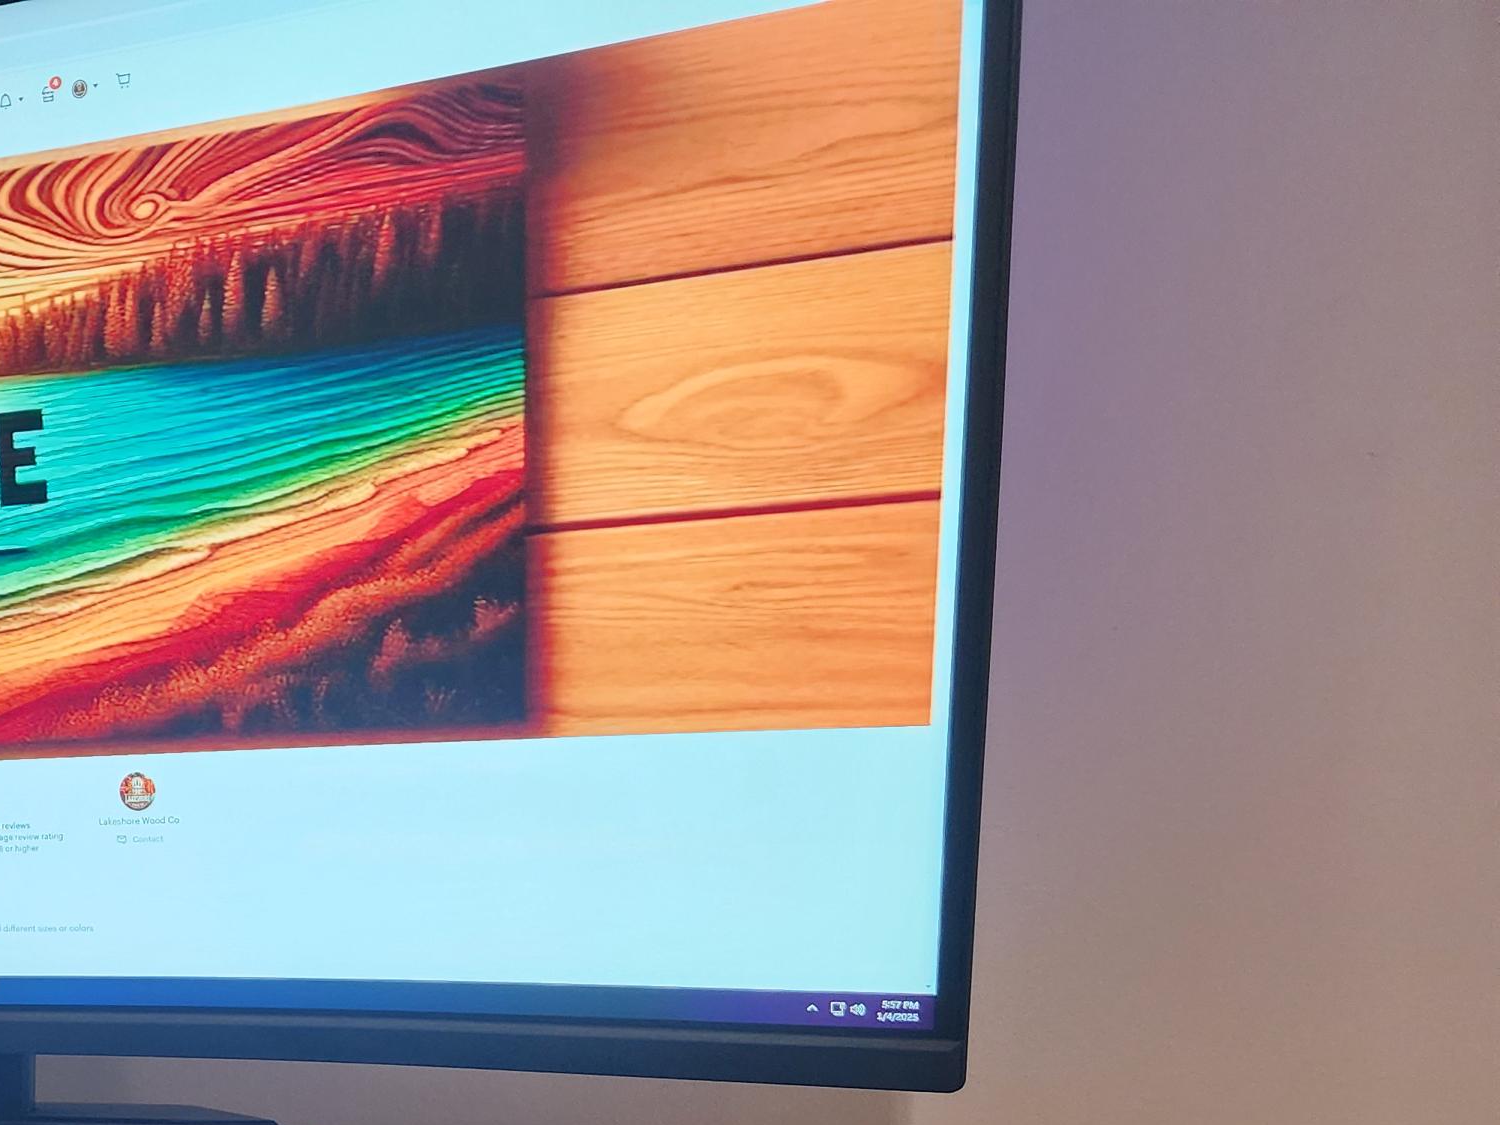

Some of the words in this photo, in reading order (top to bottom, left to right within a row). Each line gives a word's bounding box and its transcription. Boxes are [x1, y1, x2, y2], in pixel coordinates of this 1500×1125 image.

[99, 817, 140, 826] Lakeshore
[142, 816, 165, 825] Wood
[168, 816, 180, 824] Co
[15, 833, 39, 841] review
[41, 832, 63, 842] rating
[133, 835, 164, 843] Contact
[15, 844, 39, 853] higher
[882, 1000, 901, 1009] 5:57
[903, 1001, 919, 1010] PM
[877, 1013, 919, 1021] 1/4/2025
